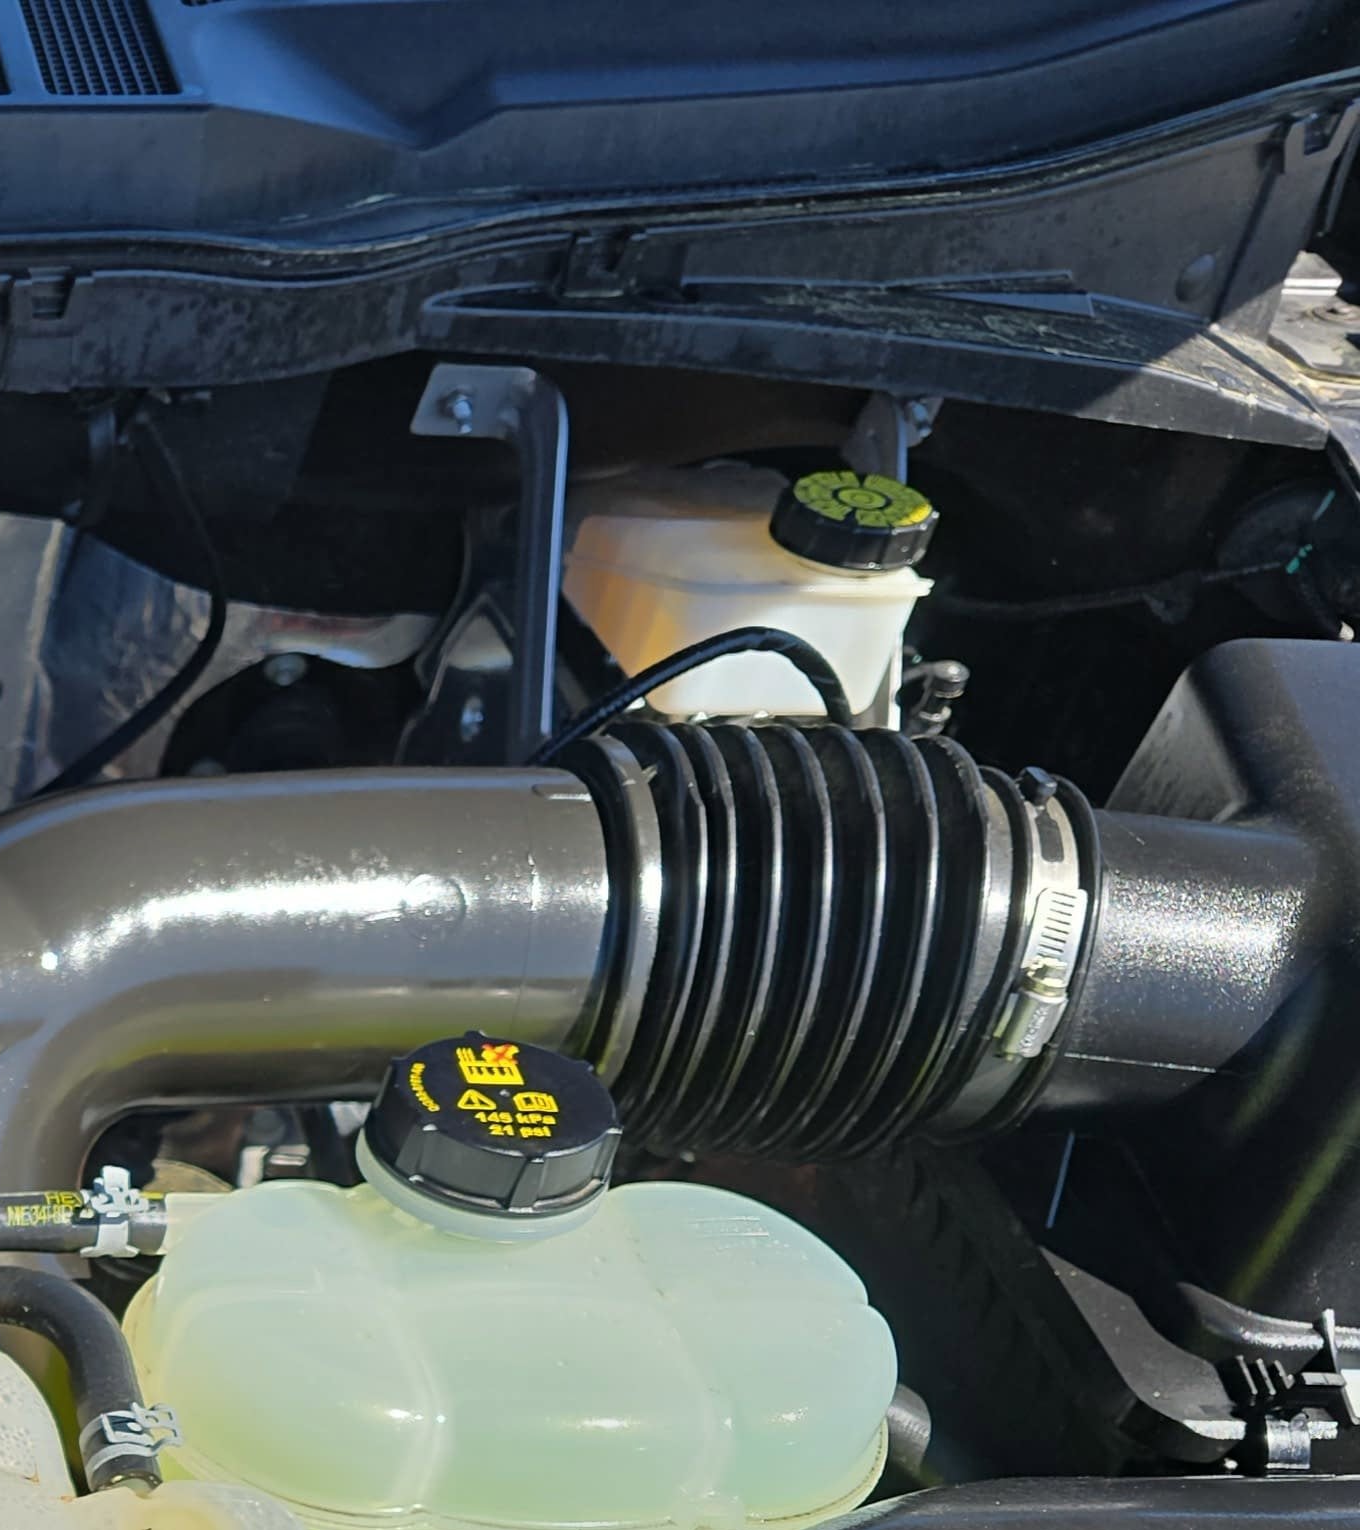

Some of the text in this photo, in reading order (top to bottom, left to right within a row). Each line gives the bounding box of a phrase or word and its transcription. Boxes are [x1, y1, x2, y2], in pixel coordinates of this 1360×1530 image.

[474, 1111, 557, 1126] 145 kPa
[488, 1124, 552, 1139] 21 psi
